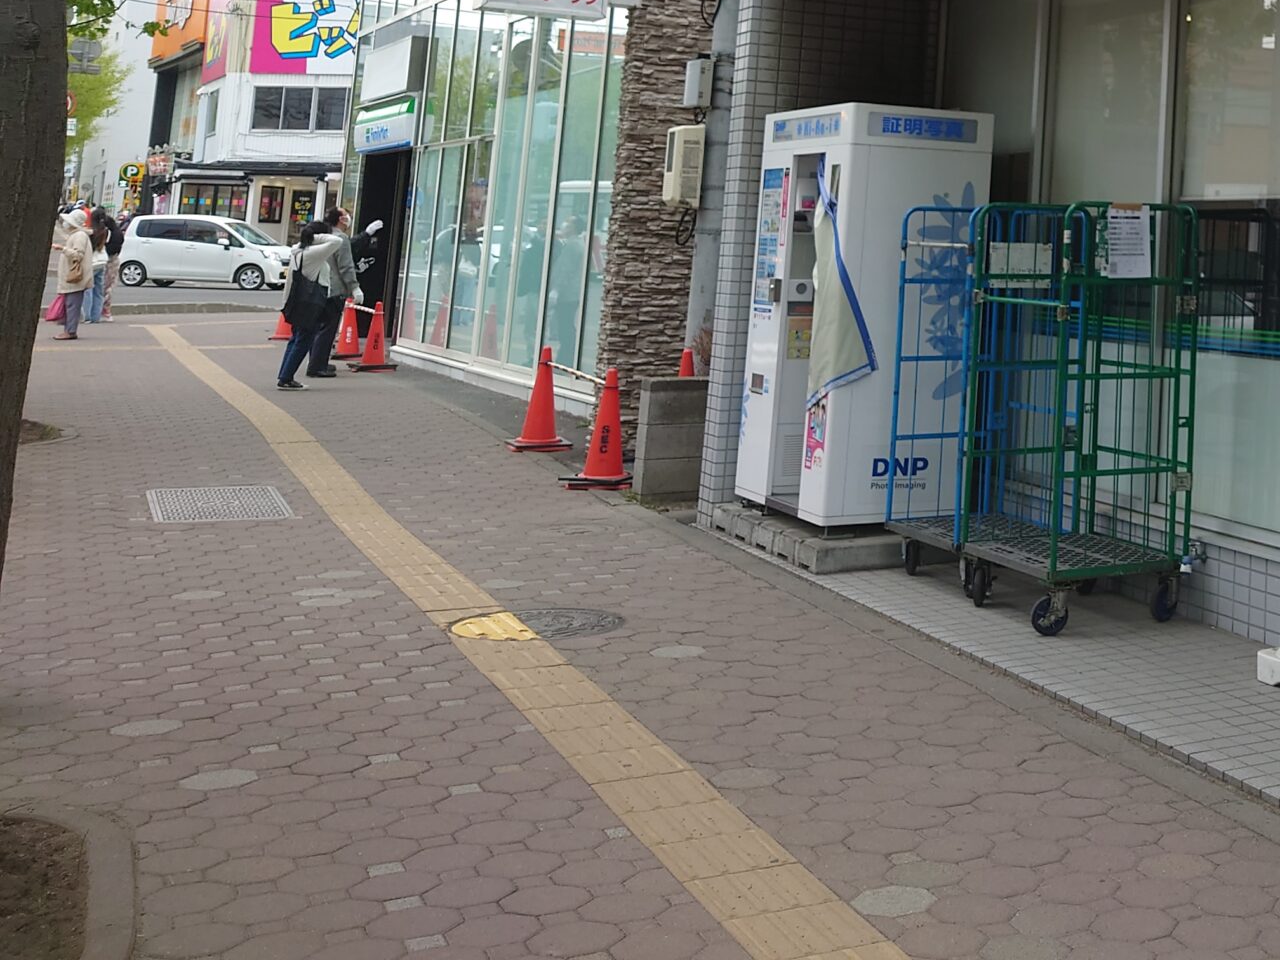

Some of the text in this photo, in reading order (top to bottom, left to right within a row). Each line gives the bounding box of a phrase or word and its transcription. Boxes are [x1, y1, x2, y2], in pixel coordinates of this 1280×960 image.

[126, 166, 138, 178] P
[599, 425, 610, 454] SEC
[872, 457, 928, 477] DNP
[870, 482, 890, 490] Phot
